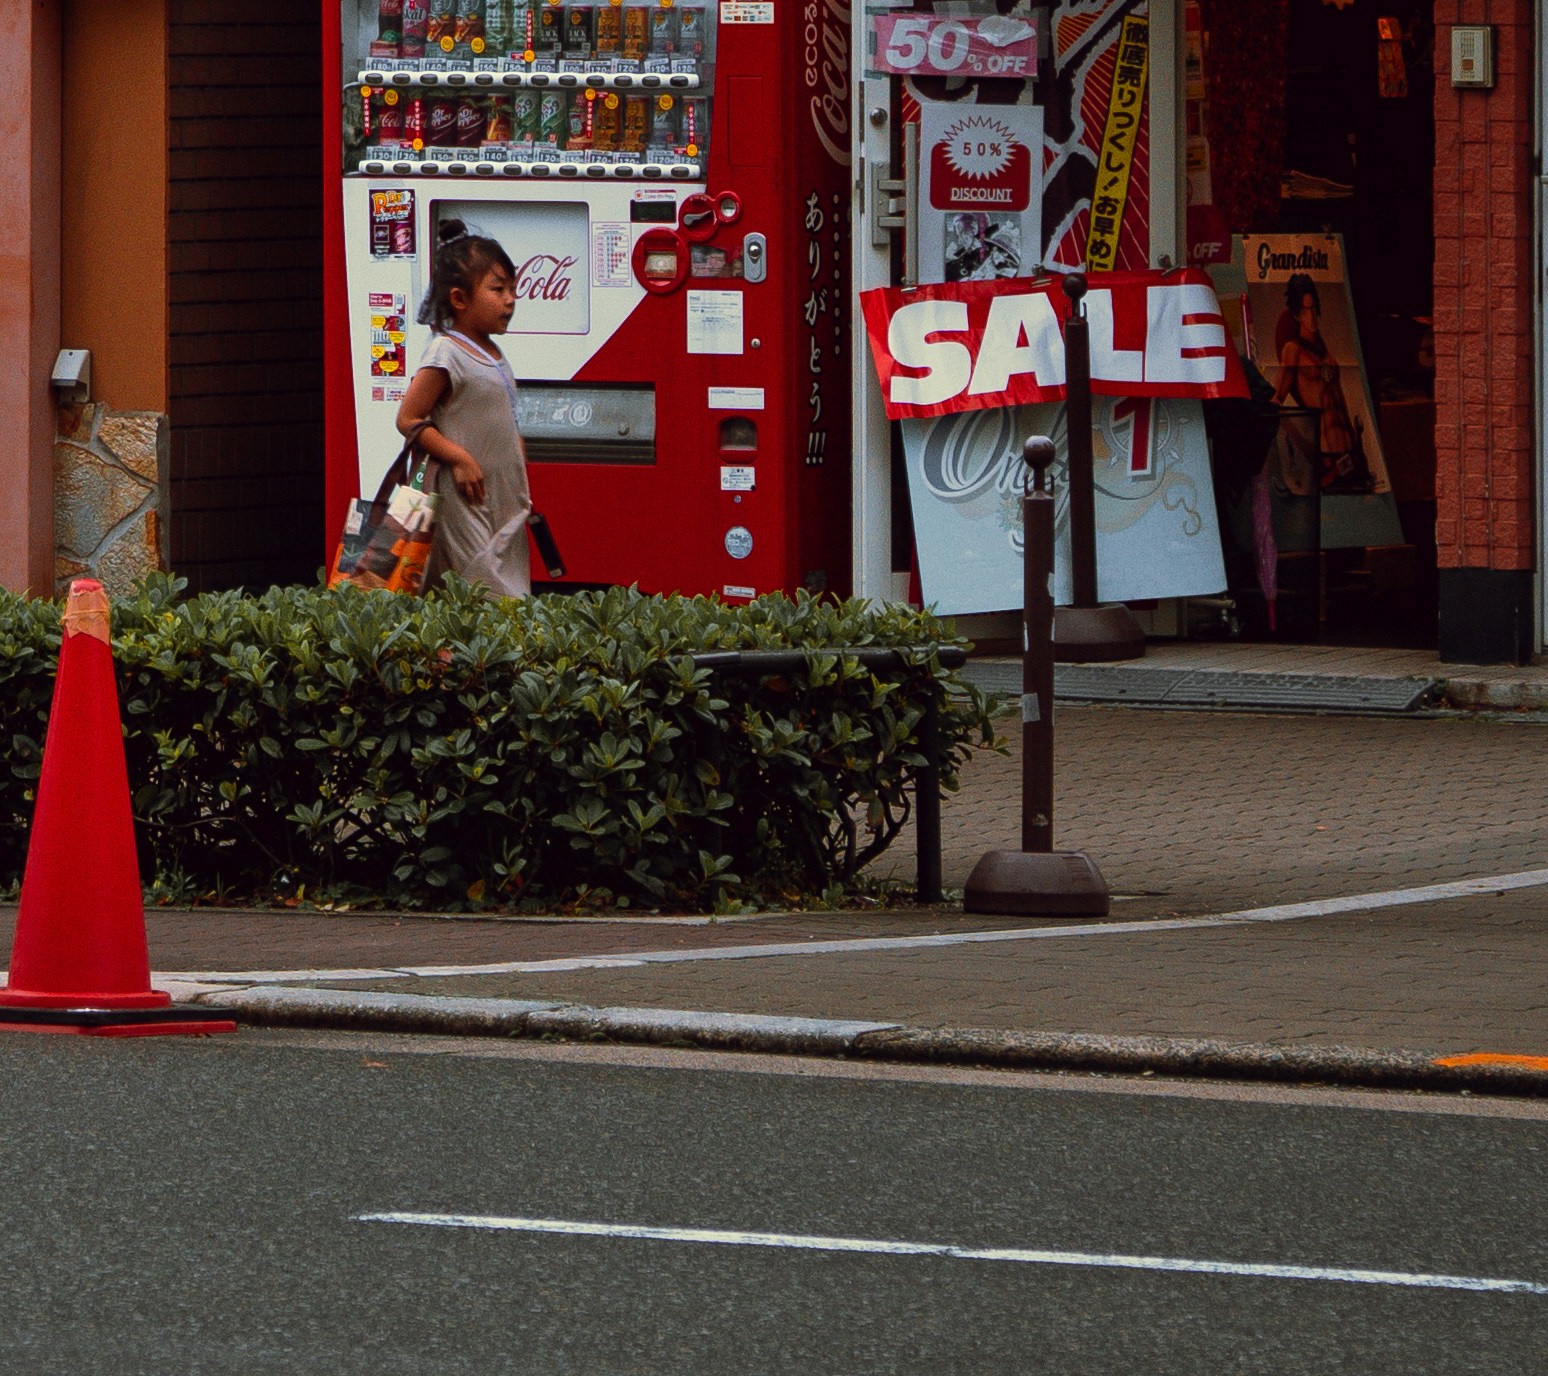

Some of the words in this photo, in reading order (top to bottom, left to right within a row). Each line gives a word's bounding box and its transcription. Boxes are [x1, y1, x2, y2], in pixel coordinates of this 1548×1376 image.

[885, 18, 984, 73] 50%
[987, 54, 1029, 74] OFF
[950, 186, 1014, 203] DISCOUNT
[1193, 241, 1223, 260] OFF
[515, 253, 580, 302] Cola
[888, 283, 1227, 406] SALE
